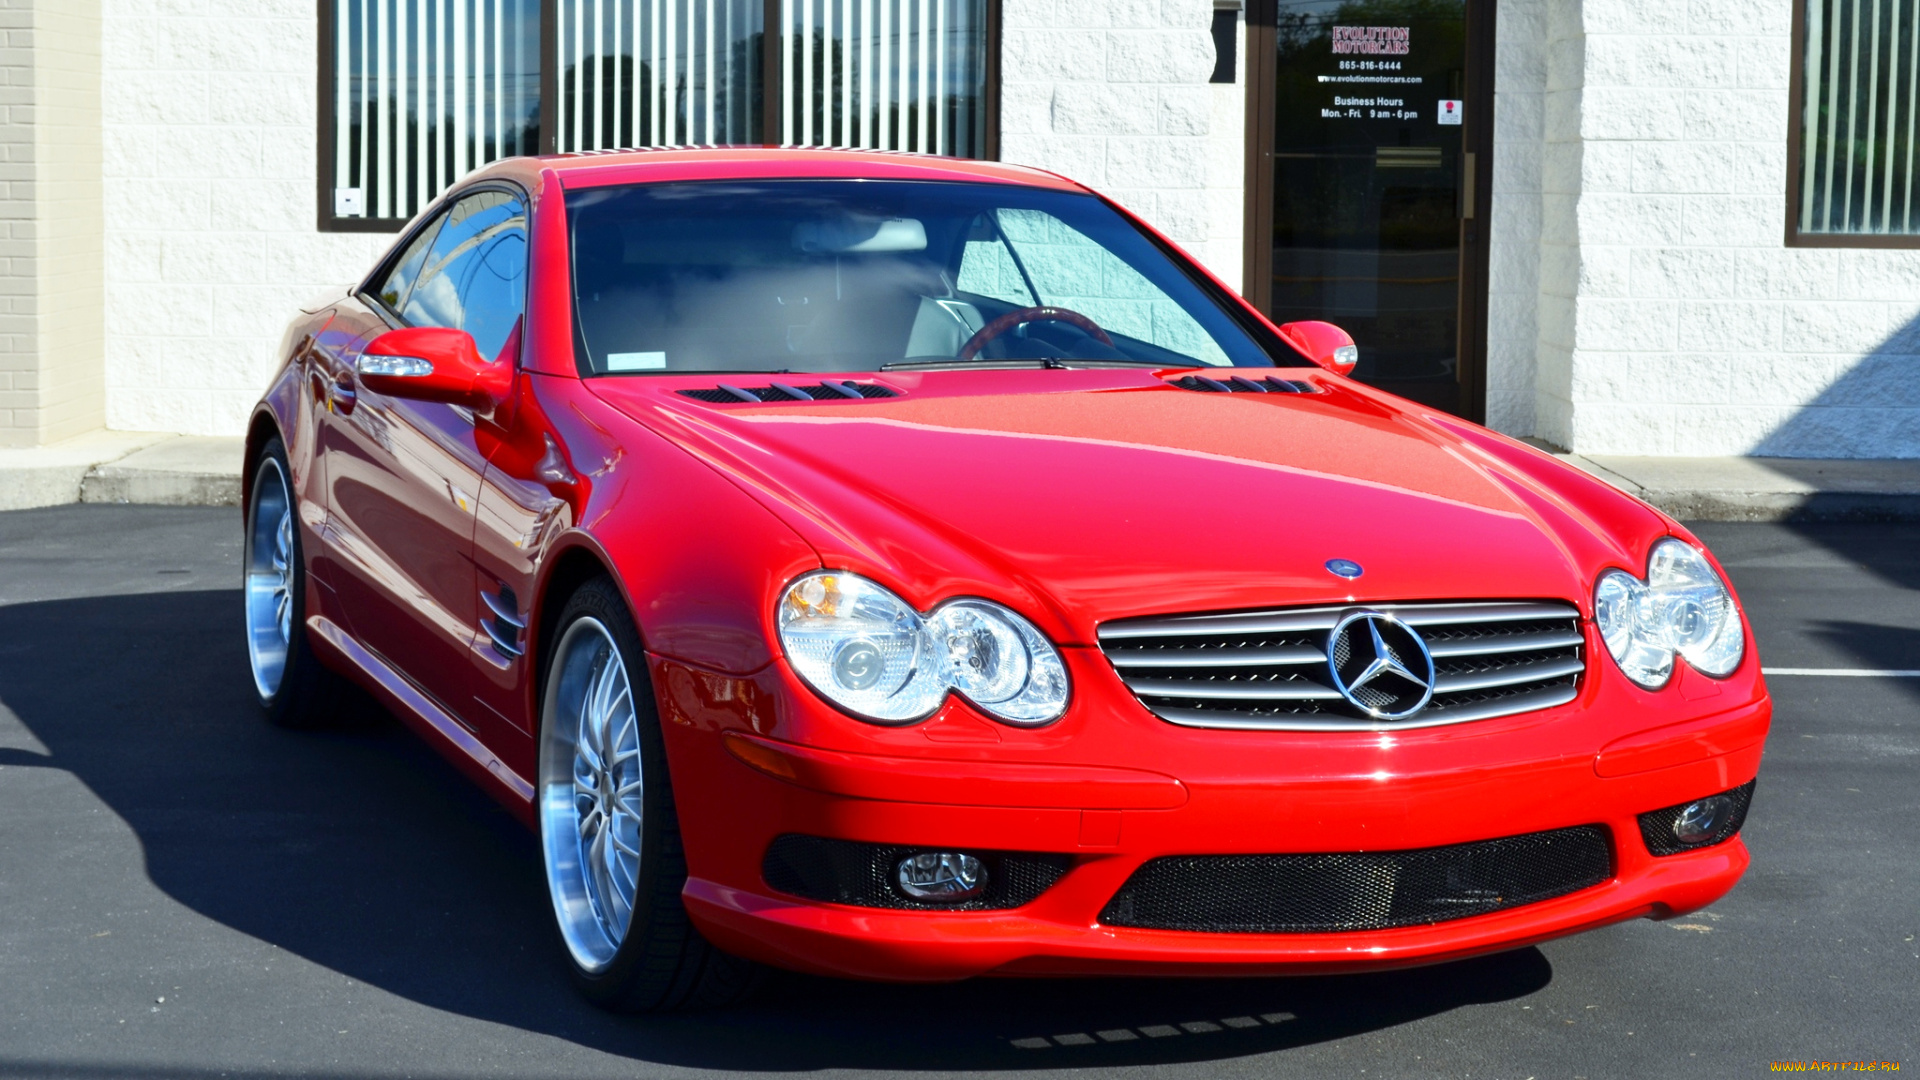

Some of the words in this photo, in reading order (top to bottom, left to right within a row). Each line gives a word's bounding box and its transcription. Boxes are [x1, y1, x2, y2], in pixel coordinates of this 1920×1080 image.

[1332, 26, 1410, 40] EVOLUTION
[1332, 40, 1410, 55] MOTORCARS
[1339, 61, 1401, 70] 865-816-6444
[1317, 75, 1422, 83] www.evolutionmotorcars.com
[1334, 96, 1375, 106] Business
[1377, 97, 1404, 106] Hours
[1321, 108, 1342, 118] Mon.
[1370, 109, 1376, 118] 9
[1397, 110, 1403, 118] 6
[1404, 111, 1418, 120] pm
